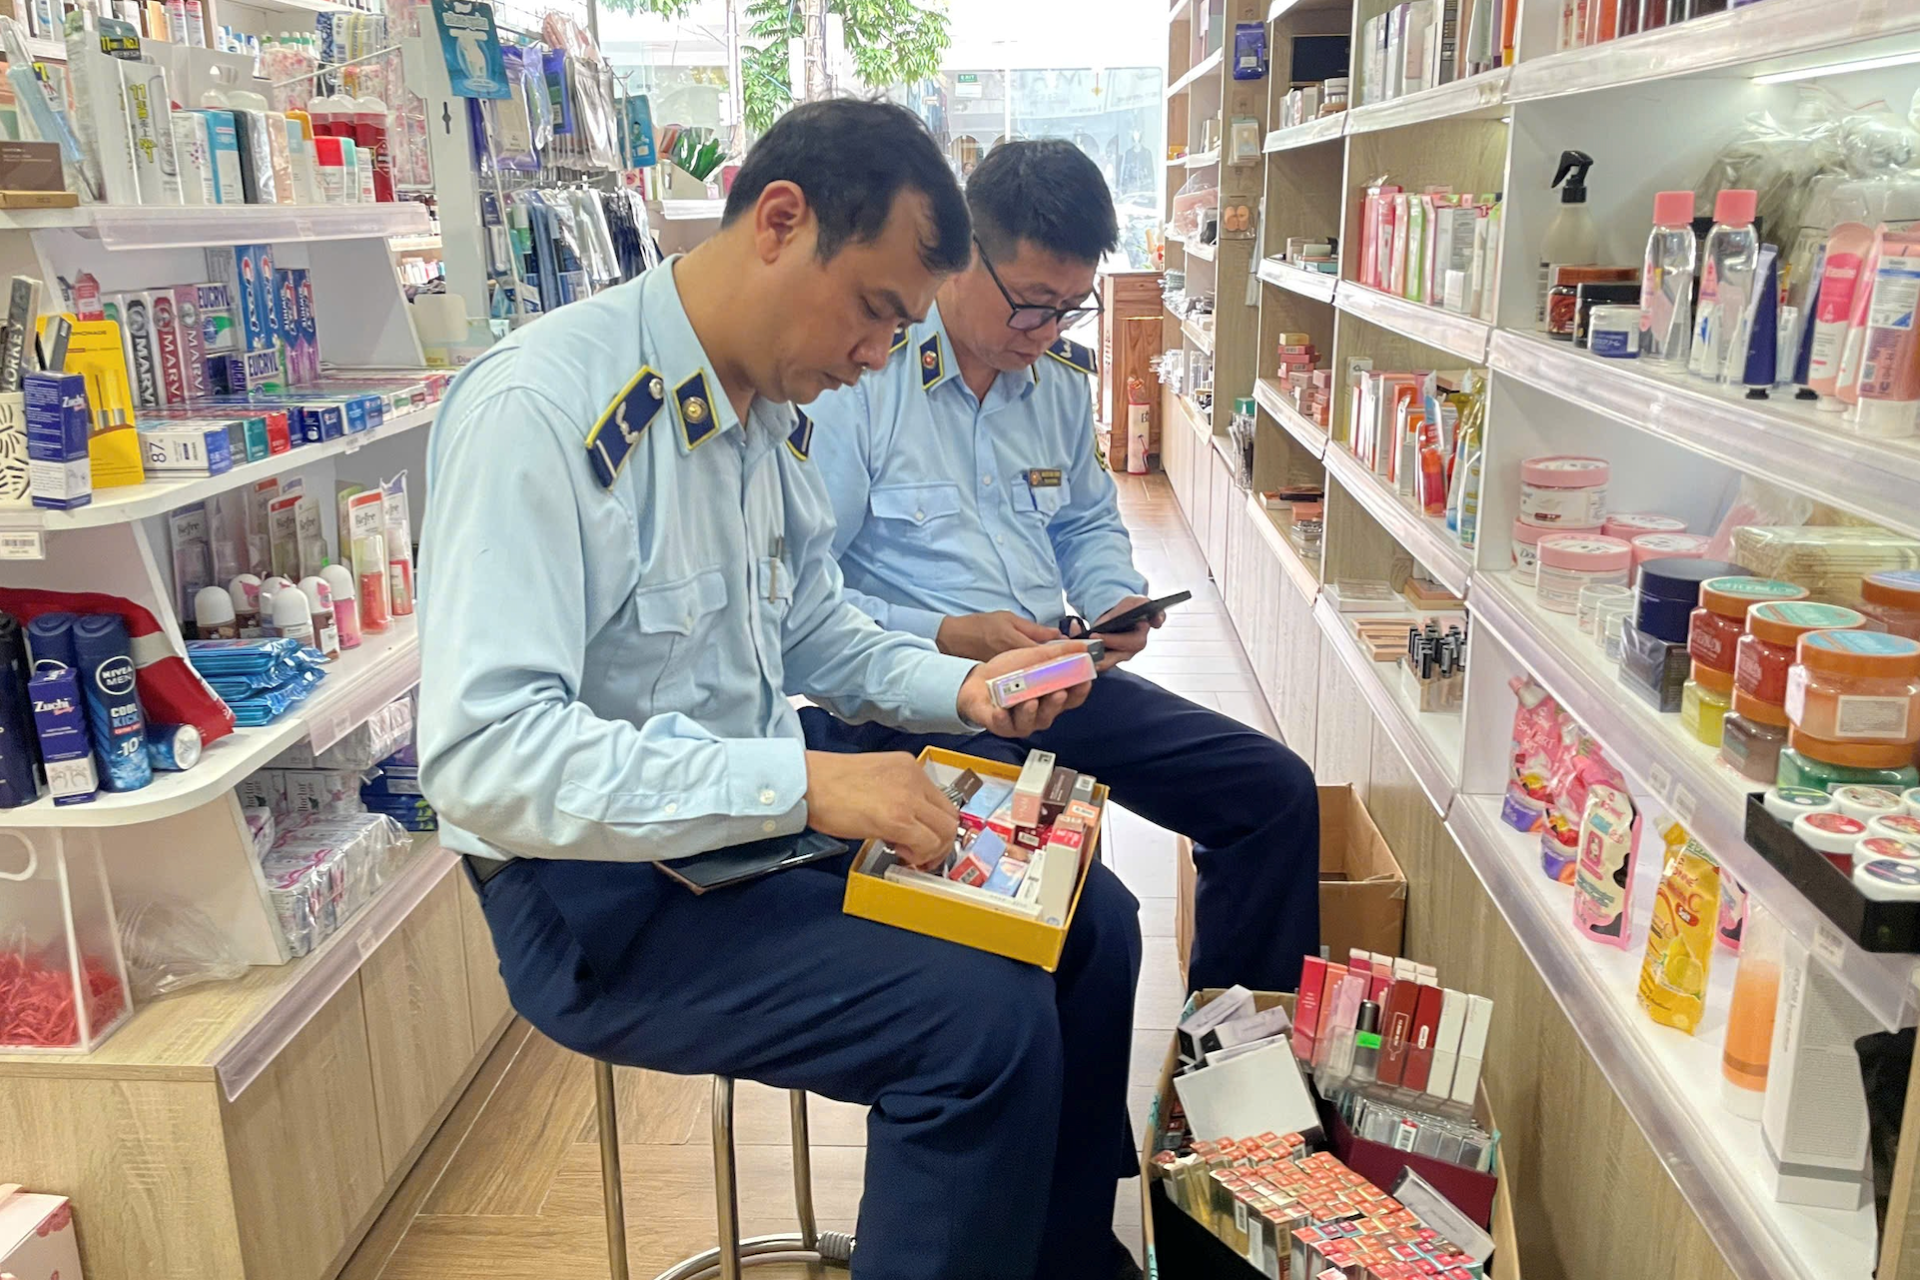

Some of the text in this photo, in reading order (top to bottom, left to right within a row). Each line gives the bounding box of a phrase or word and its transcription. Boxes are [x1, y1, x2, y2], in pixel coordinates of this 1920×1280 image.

[102, 666, 133, 679] NIVEA
[106, 674, 132, 686] MEN
[33, 698, 71, 713] Zuchi
[110, 703, 138, 718] COOL
